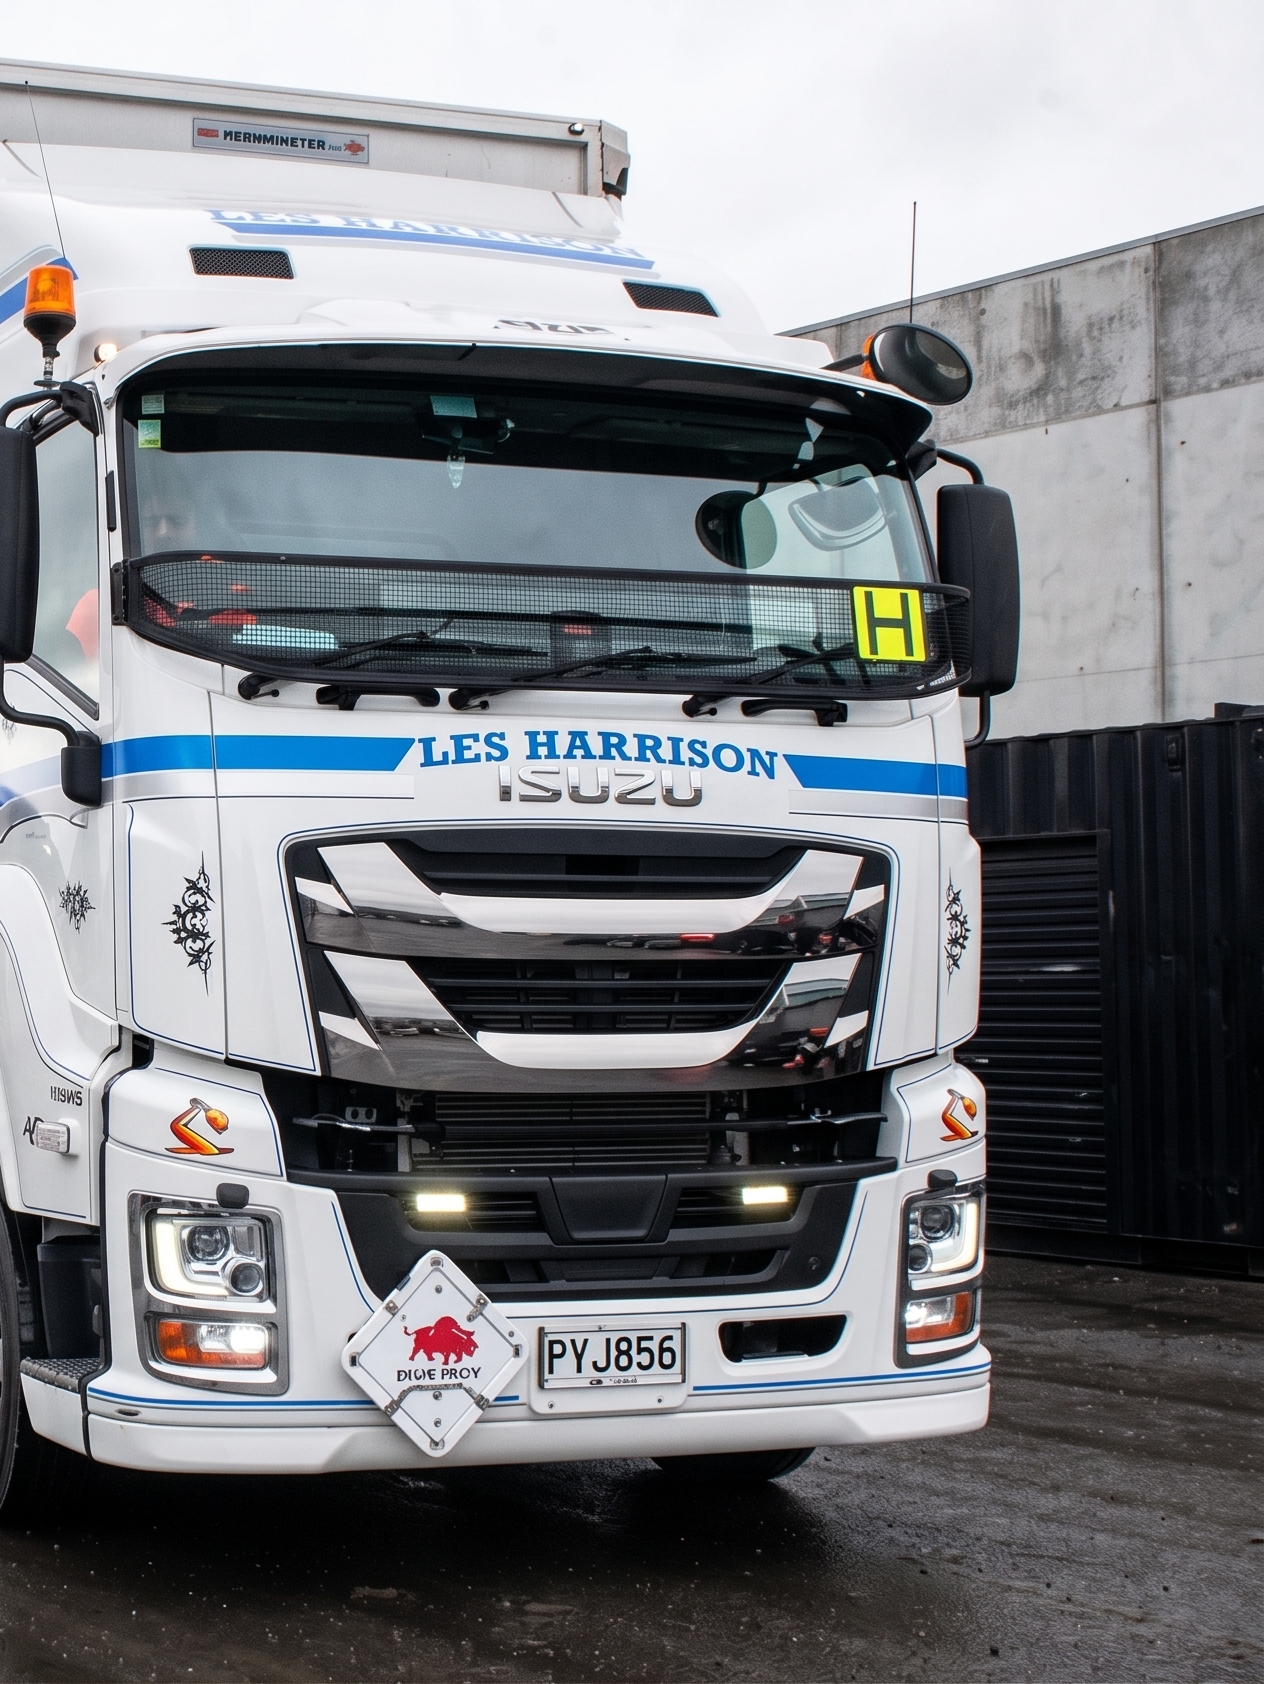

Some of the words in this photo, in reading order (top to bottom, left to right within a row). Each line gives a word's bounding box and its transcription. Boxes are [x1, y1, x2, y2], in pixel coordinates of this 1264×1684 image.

[864, 591, 914, 657] H
[417, 731, 510, 768] LES
[524, 730, 778, 780] HARRISON
[498, 765, 704, 807] ISUZU
[547, 1335, 677, 1375] PYJ856
